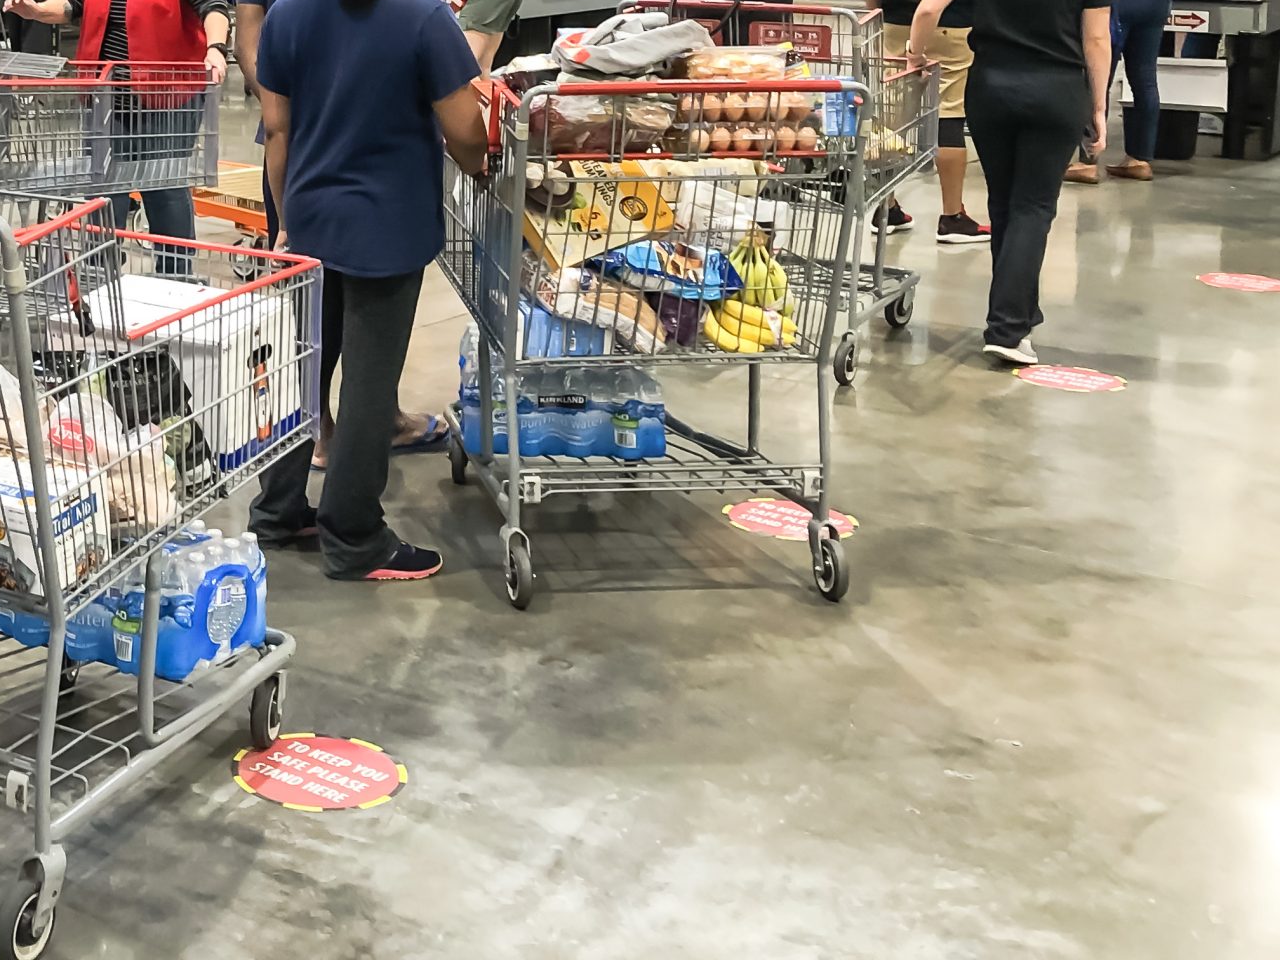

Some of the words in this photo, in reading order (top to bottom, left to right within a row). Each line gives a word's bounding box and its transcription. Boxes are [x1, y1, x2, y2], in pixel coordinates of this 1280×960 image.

[793, 46, 819, 54] OLESALE
[580, 160, 614, 206] UMINGS
[540, 396, 585, 404] KIRKLAND
[520, 416, 568, 430] purified
[572, 417, 604, 430] water
[747, 508, 781, 519] SAFE
[758, 502, 776, 510] TO
[777, 506, 813, 517] KEEP
[52, 516, 72, 535] Trai
[738, 514, 783, 527] STAND
[287, 741, 312, 754] TO
[309, 749, 353, 768] KEEP
[352, 764, 390, 783] YOU
[267, 751, 309, 772] SAFE
[308, 766, 370, 793] PLEASE
[249, 762, 305, 786] STAND
[301, 781, 351, 803] HERE
